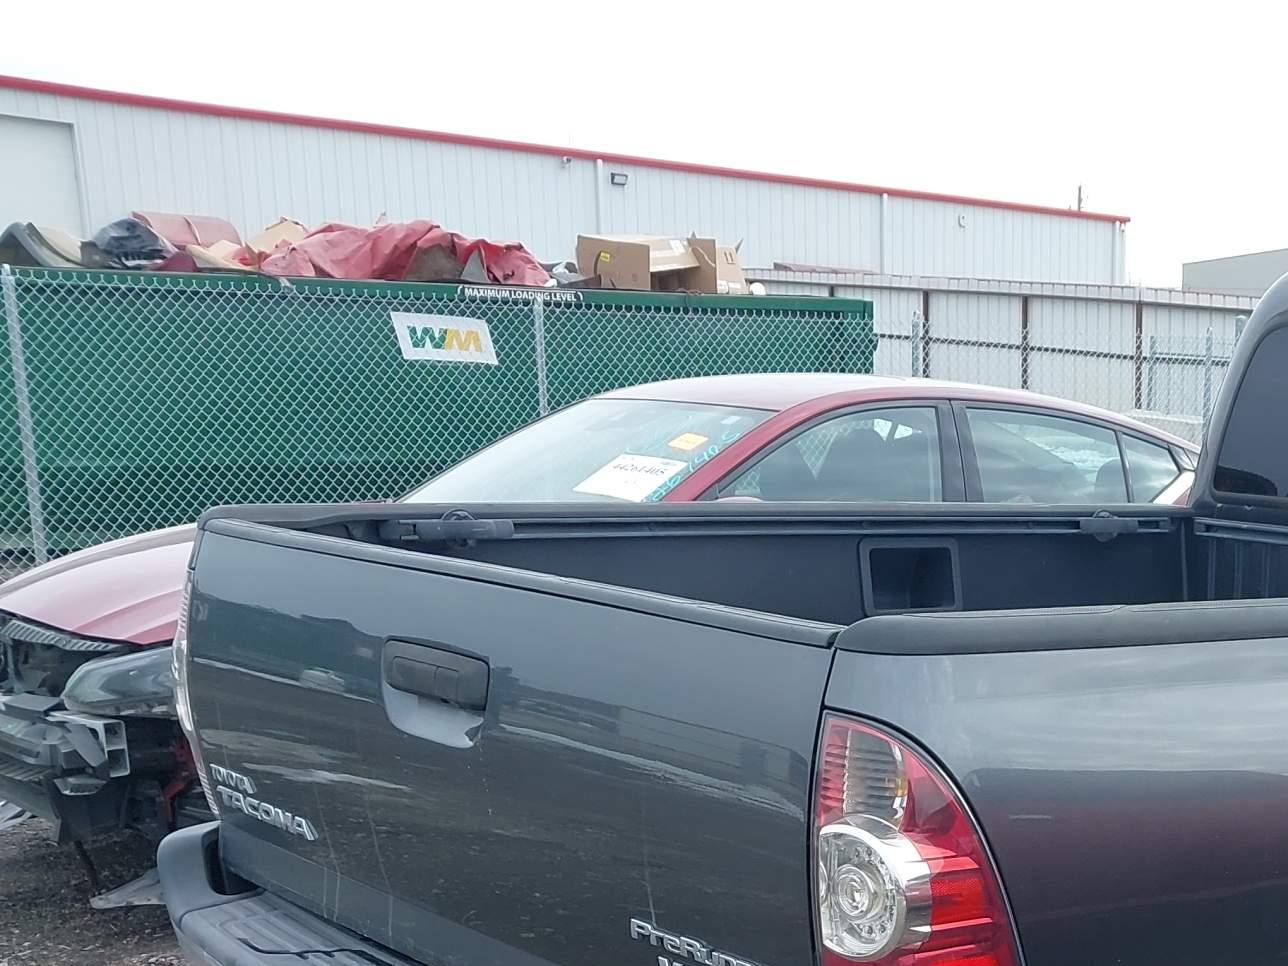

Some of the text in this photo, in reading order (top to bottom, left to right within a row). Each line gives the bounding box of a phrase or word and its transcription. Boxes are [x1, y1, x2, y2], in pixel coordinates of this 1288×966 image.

[464, 286, 577, 302] MAXIMUM LOADING LEVEL
[407, 325, 483, 353] WM
[209, 763, 257, 794] TOYOTA
[216, 785, 318, 841] TACOMA
